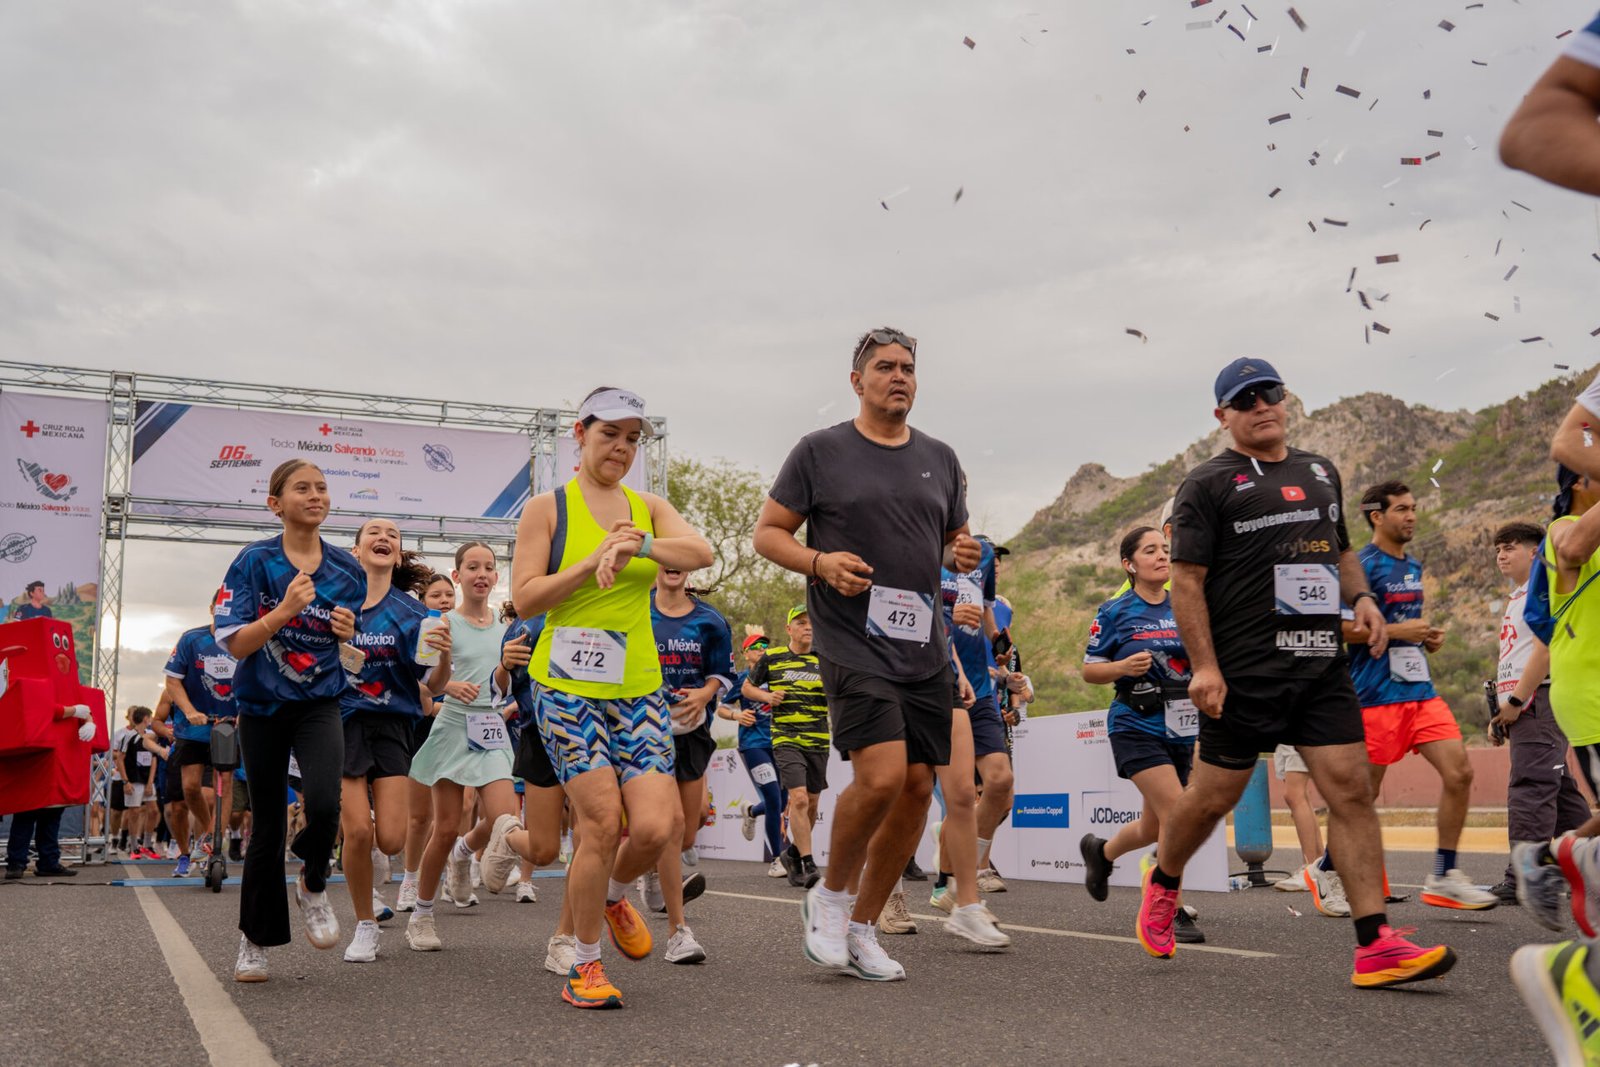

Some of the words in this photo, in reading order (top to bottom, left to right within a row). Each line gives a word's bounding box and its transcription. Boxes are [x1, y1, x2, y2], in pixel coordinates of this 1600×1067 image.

[41, 430, 84, 439] MEXICANA
[42, 423, 63, 431] CRUZ
[64, 425, 85, 433] ROJA
[218, 445, 247, 460] 06
[270, 438, 296, 449] Todo
[297, 440, 333, 453] México
[334, 442, 376, 456] Salvando
[379, 447, 405, 458] Vidas
[209, 458, 263, 469] SEPTIEMBRE
[351, 469, 380, 479] Coppel
[16, 502, 41, 511] México
[41, 503, 71, 512] Salvando
[1298, 585, 1327, 601] 548
[301, 604, 331, 620] éxico
[887, 609, 917, 628] 473
[355, 631, 396, 646] México
[571, 649, 605, 668] 472
[1088, 719, 1105, 729] México
[1178, 713, 1198, 727] 172
[482, 728, 503, 740] 276
[1023, 806, 1046, 815] Fundación
[1046, 806, 1064, 816] Coppel
[1090, 807, 1142, 825] JCDecau
